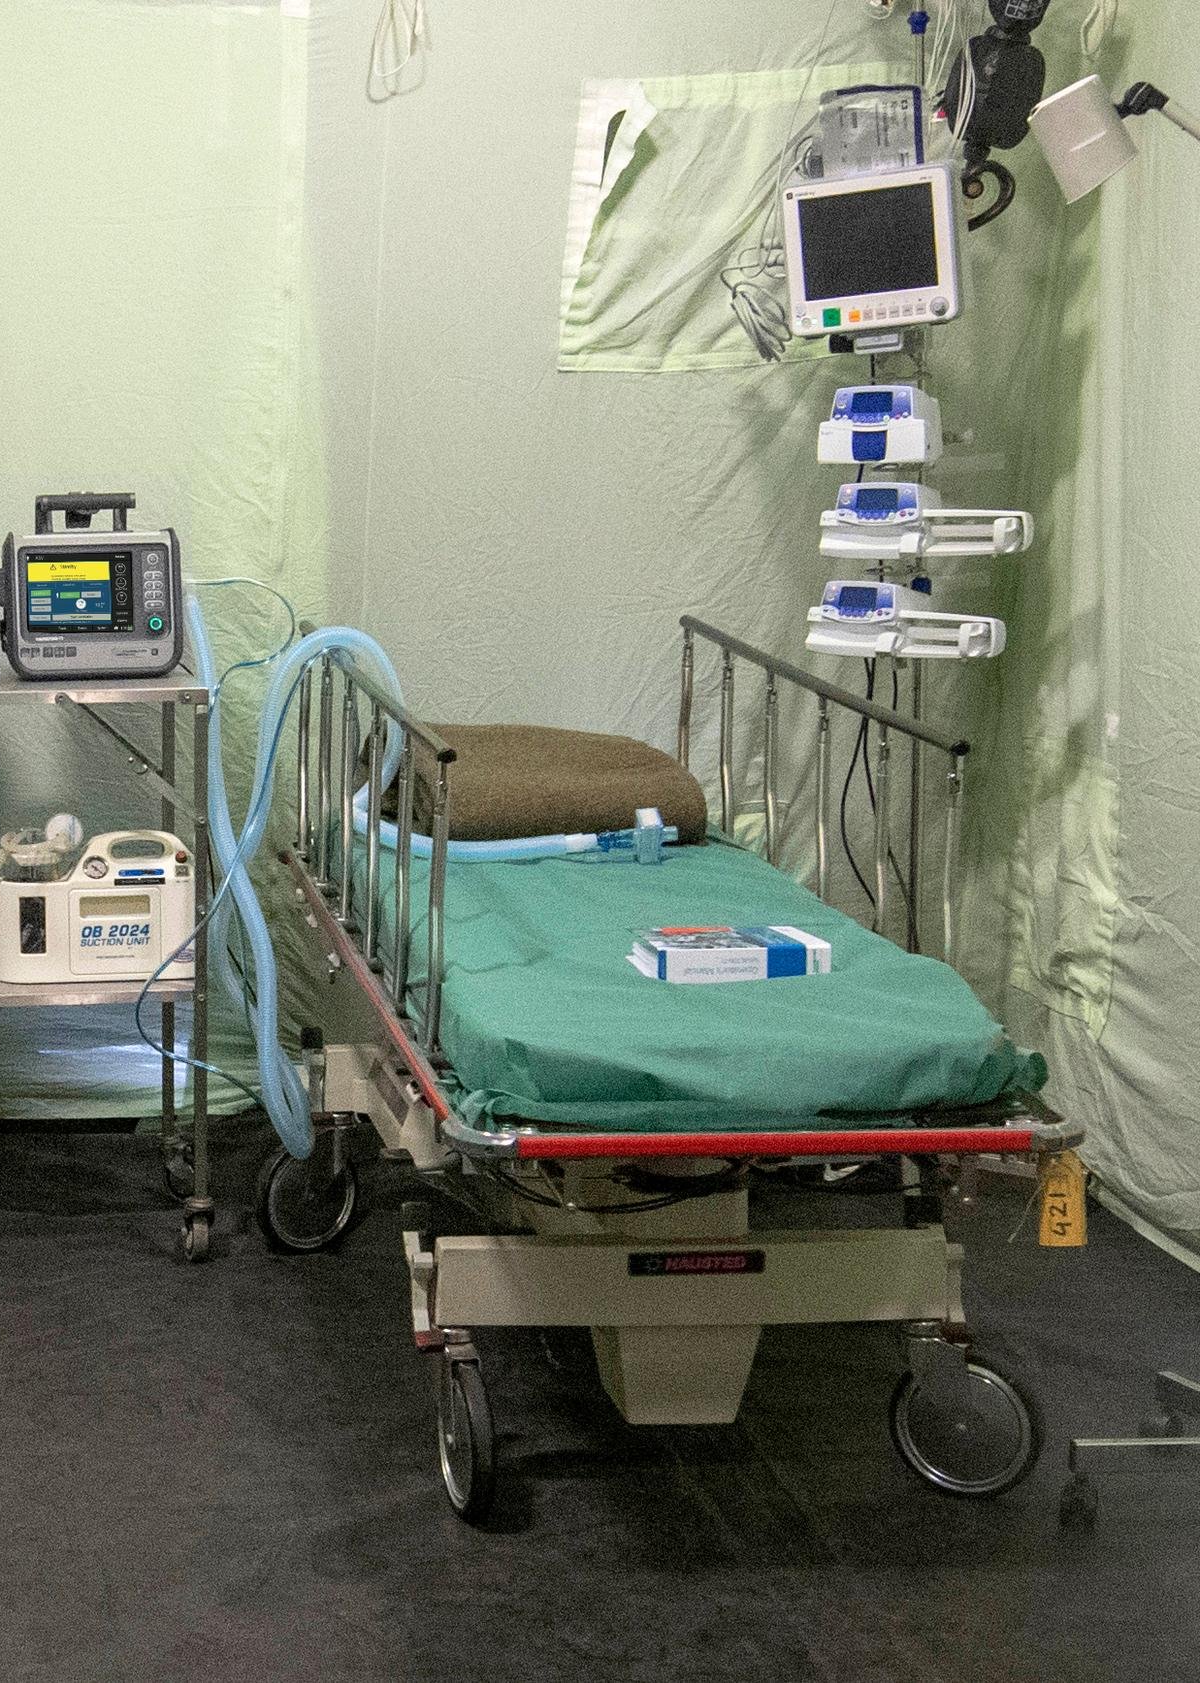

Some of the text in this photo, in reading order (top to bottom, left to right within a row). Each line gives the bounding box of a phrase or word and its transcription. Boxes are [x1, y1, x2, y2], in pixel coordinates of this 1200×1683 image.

[81, 924, 150, 938] OB 2024
[80, 936, 151, 947] SUCTION UNIT
[1048, 1192, 1072, 1236] 421
[665, 1256, 746, 1271] HAUSTED
